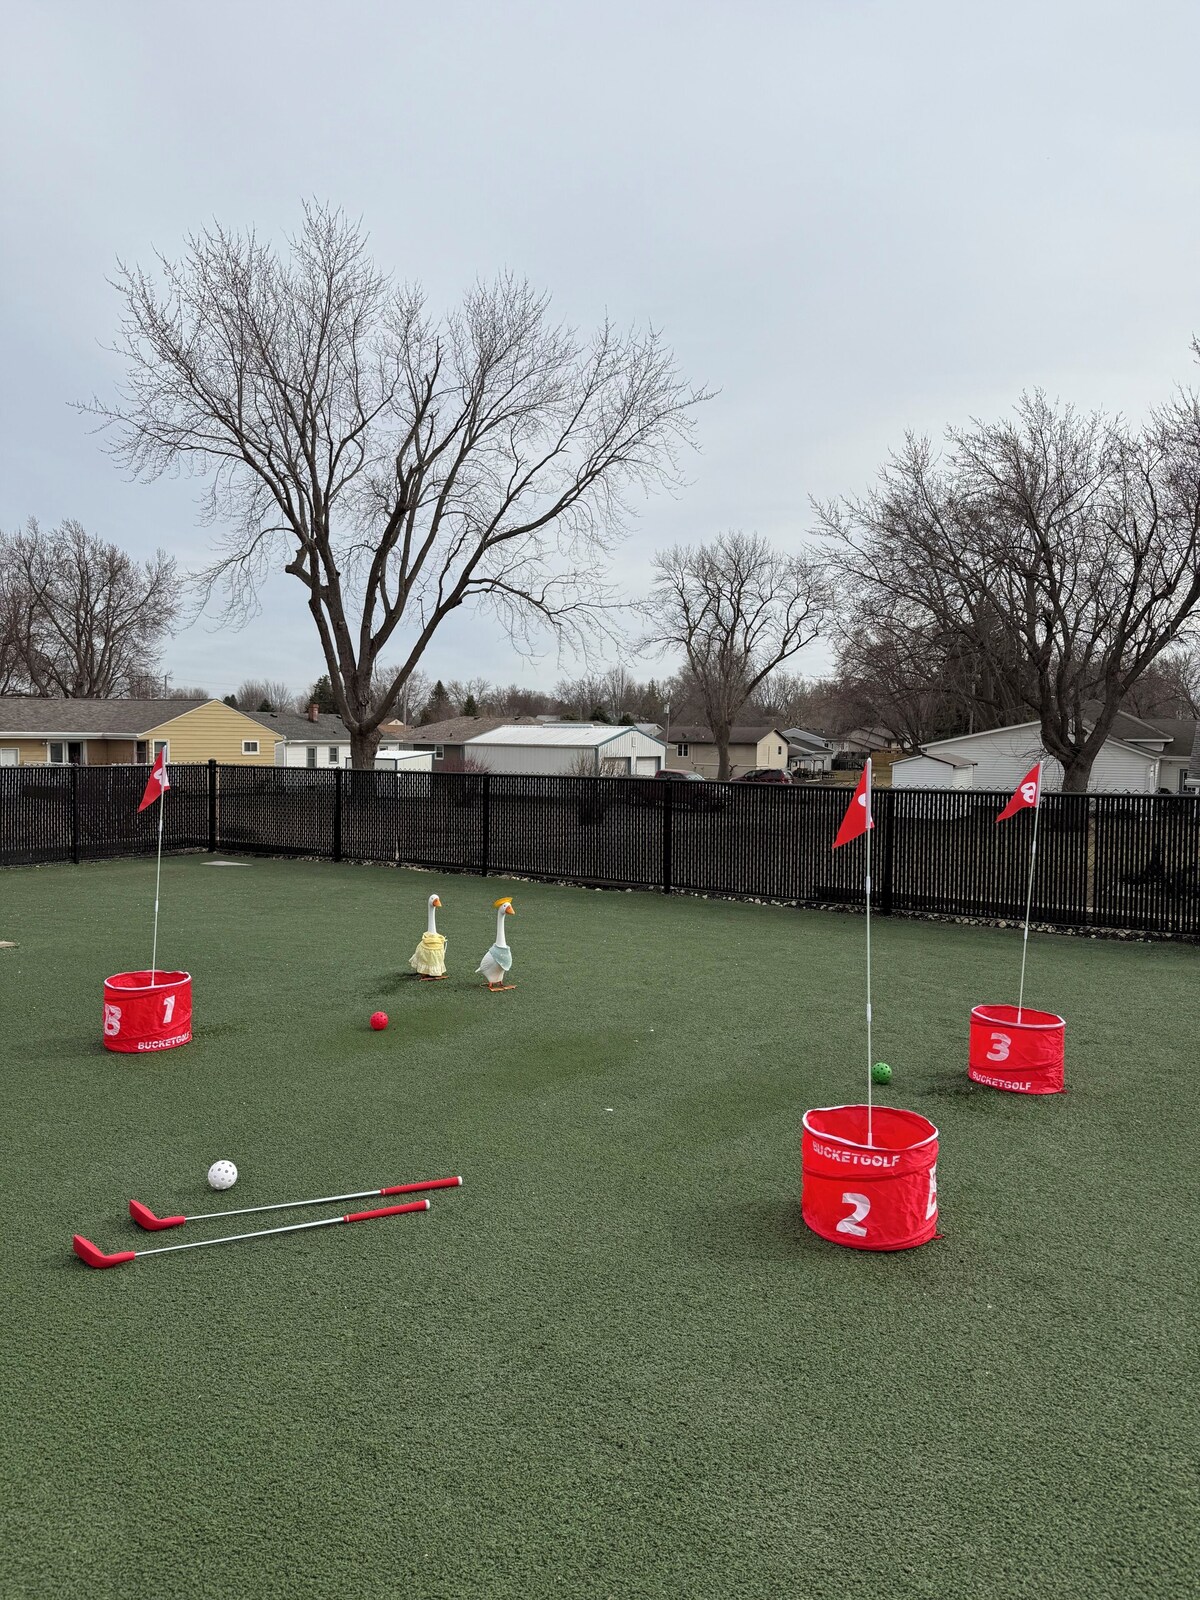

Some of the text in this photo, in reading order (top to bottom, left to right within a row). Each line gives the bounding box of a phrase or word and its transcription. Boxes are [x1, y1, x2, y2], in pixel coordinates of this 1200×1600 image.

[104, 1004, 121, 1036] B
[163, 995, 175, 1023] 1
[986, 1032, 1011, 1061] 3
[972, 1071, 1031, 1090] BUCKETGOLF
[812, 1141, 900, 1167] BUCKETGOLF
[836, 1192, 871, 1237] 2
